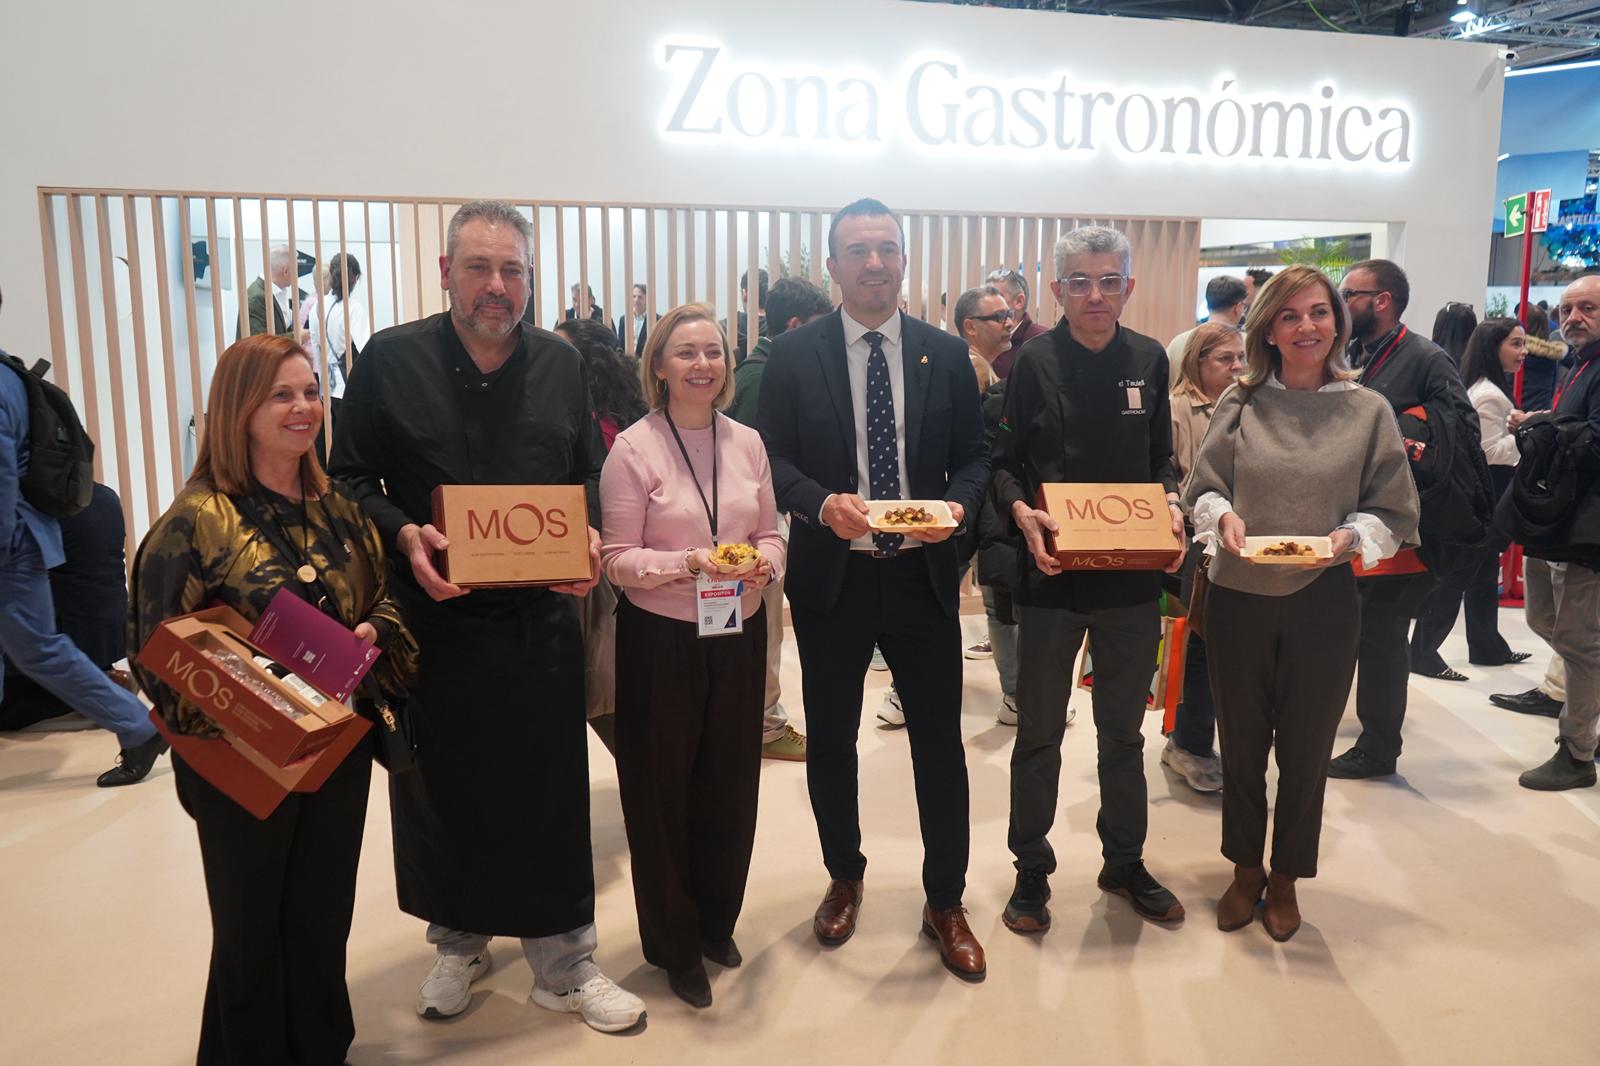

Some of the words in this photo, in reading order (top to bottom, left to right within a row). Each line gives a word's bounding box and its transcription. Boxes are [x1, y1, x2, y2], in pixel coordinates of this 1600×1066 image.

[663, 43, 882, 143] Zona
[905, 60, 1411, 163] Gastronómica
[467, 503, 569, 546] MOS
[1065, 494, 1154, 525] MOS
[1071, 555, 1126, 568] MOS
[165, 650, 235, 711] MOS
